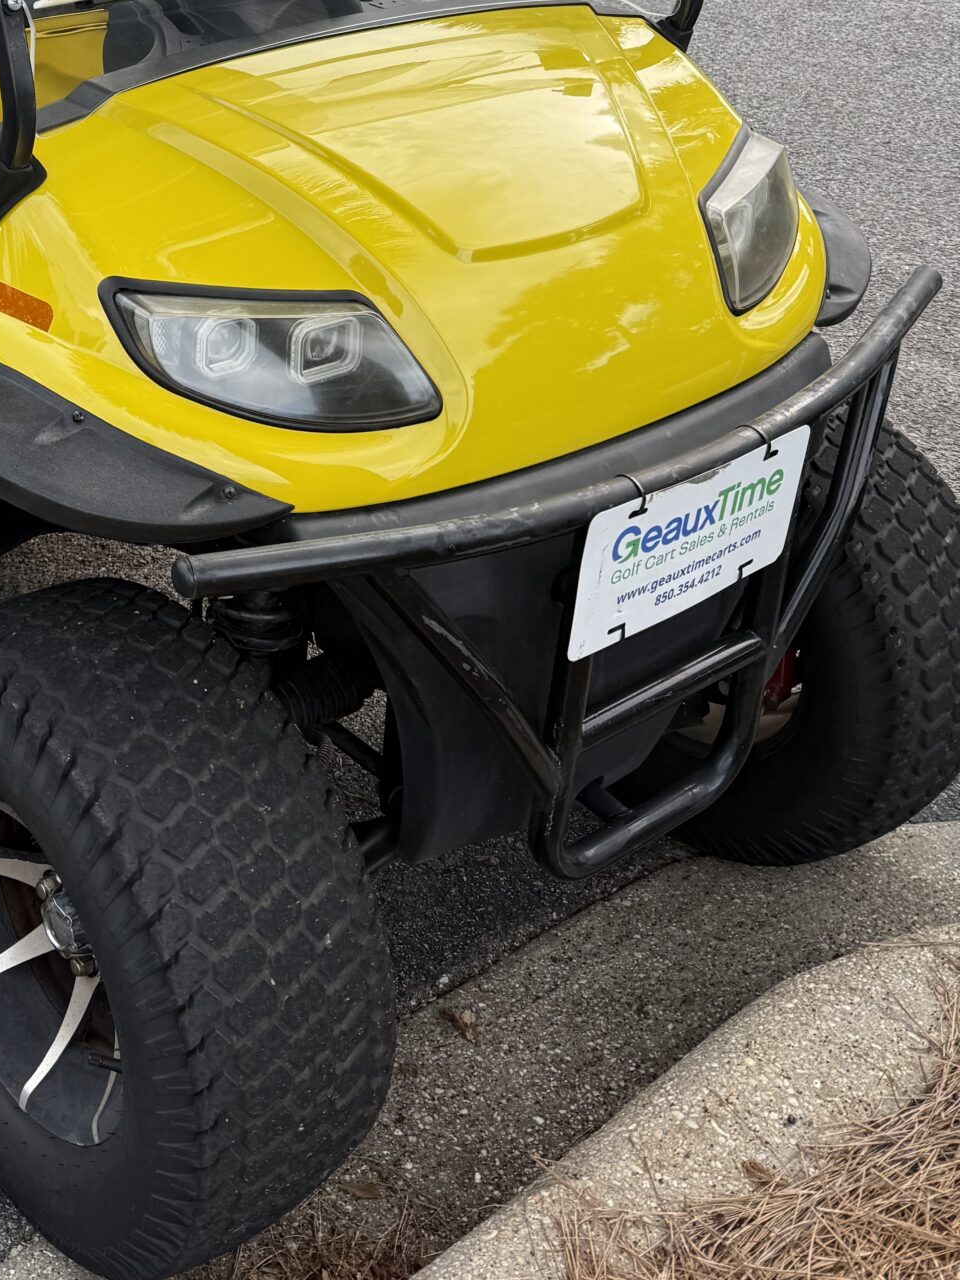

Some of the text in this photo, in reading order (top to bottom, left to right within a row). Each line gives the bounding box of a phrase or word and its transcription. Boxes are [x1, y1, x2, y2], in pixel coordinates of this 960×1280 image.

[610, 500, 775, 585] Golf Cart Sales & Rentals
[612, 468, 785, 564] GeauxTime
[616, 528, 762, 605] www.geauxtimecarts.com
[654, 565, 722, 606] 850.354.4212
